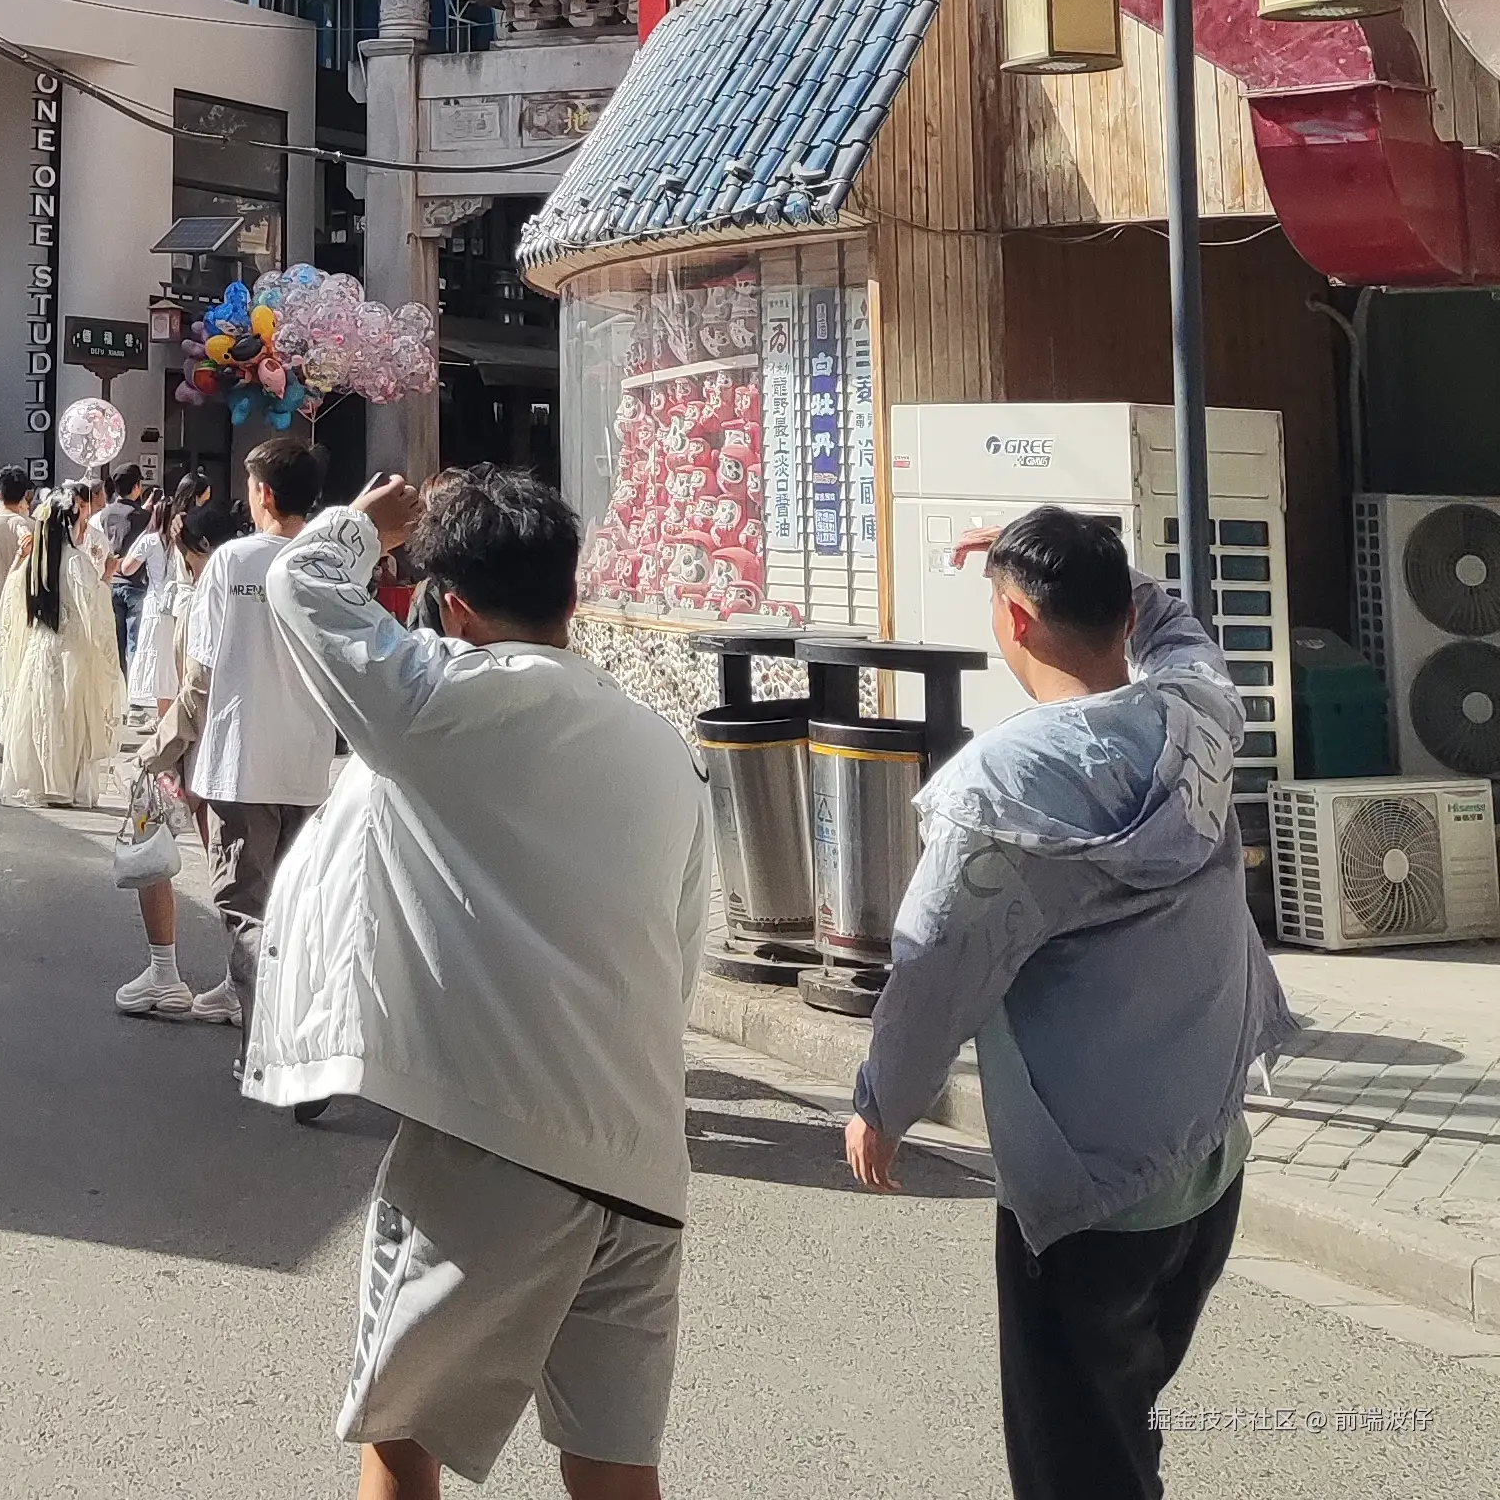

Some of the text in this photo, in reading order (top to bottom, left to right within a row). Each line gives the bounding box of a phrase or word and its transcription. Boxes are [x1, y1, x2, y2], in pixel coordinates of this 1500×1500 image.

[34, 73, 58, 152] ONE
[33, 165, 57, 247] ONE
[29, 265, 53, 432] STUDIO
[1004, 439, 1054, 454] GREE
